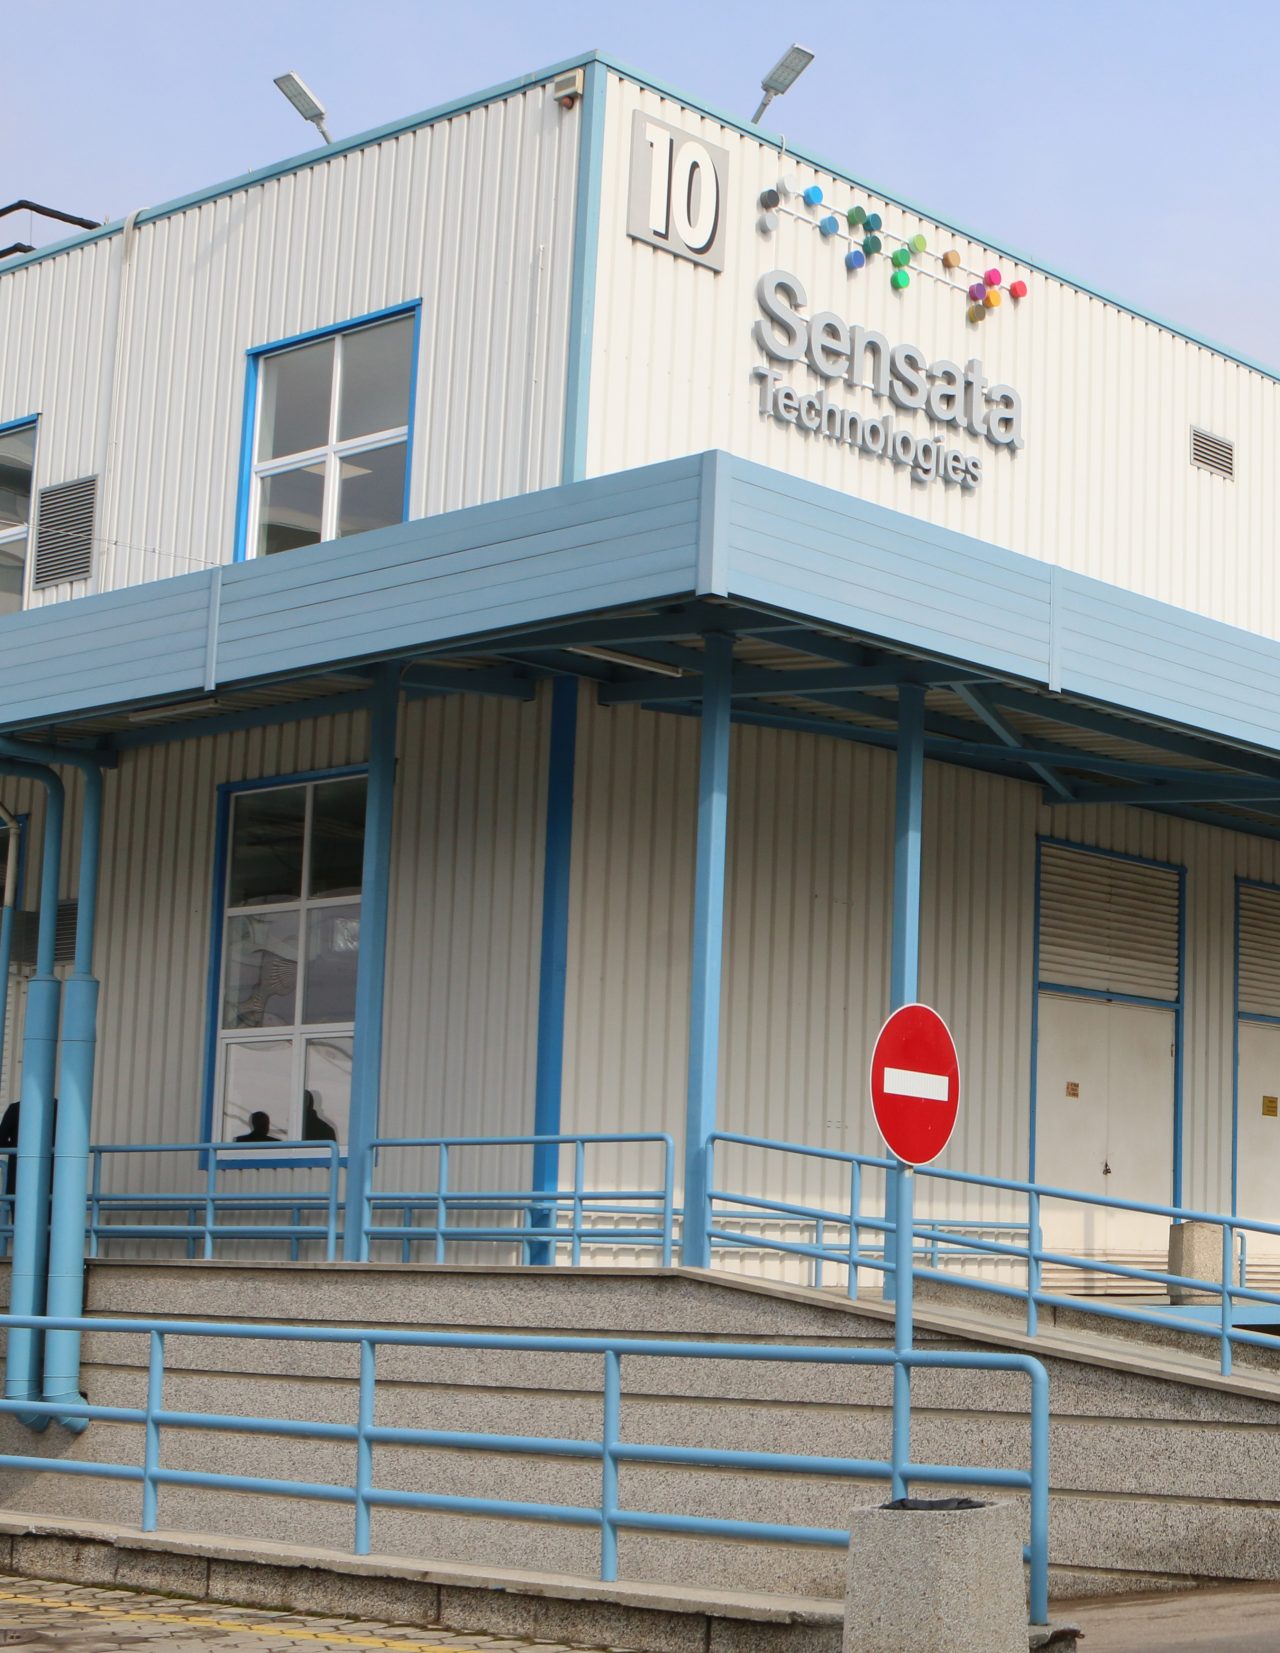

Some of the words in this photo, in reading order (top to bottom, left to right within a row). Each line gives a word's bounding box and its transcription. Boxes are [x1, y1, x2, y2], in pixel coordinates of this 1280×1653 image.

[645, 122, 719, 254] 10
[753, 270, 1024, 449] Sensata
[752, 366, 982, 488] Technologies
